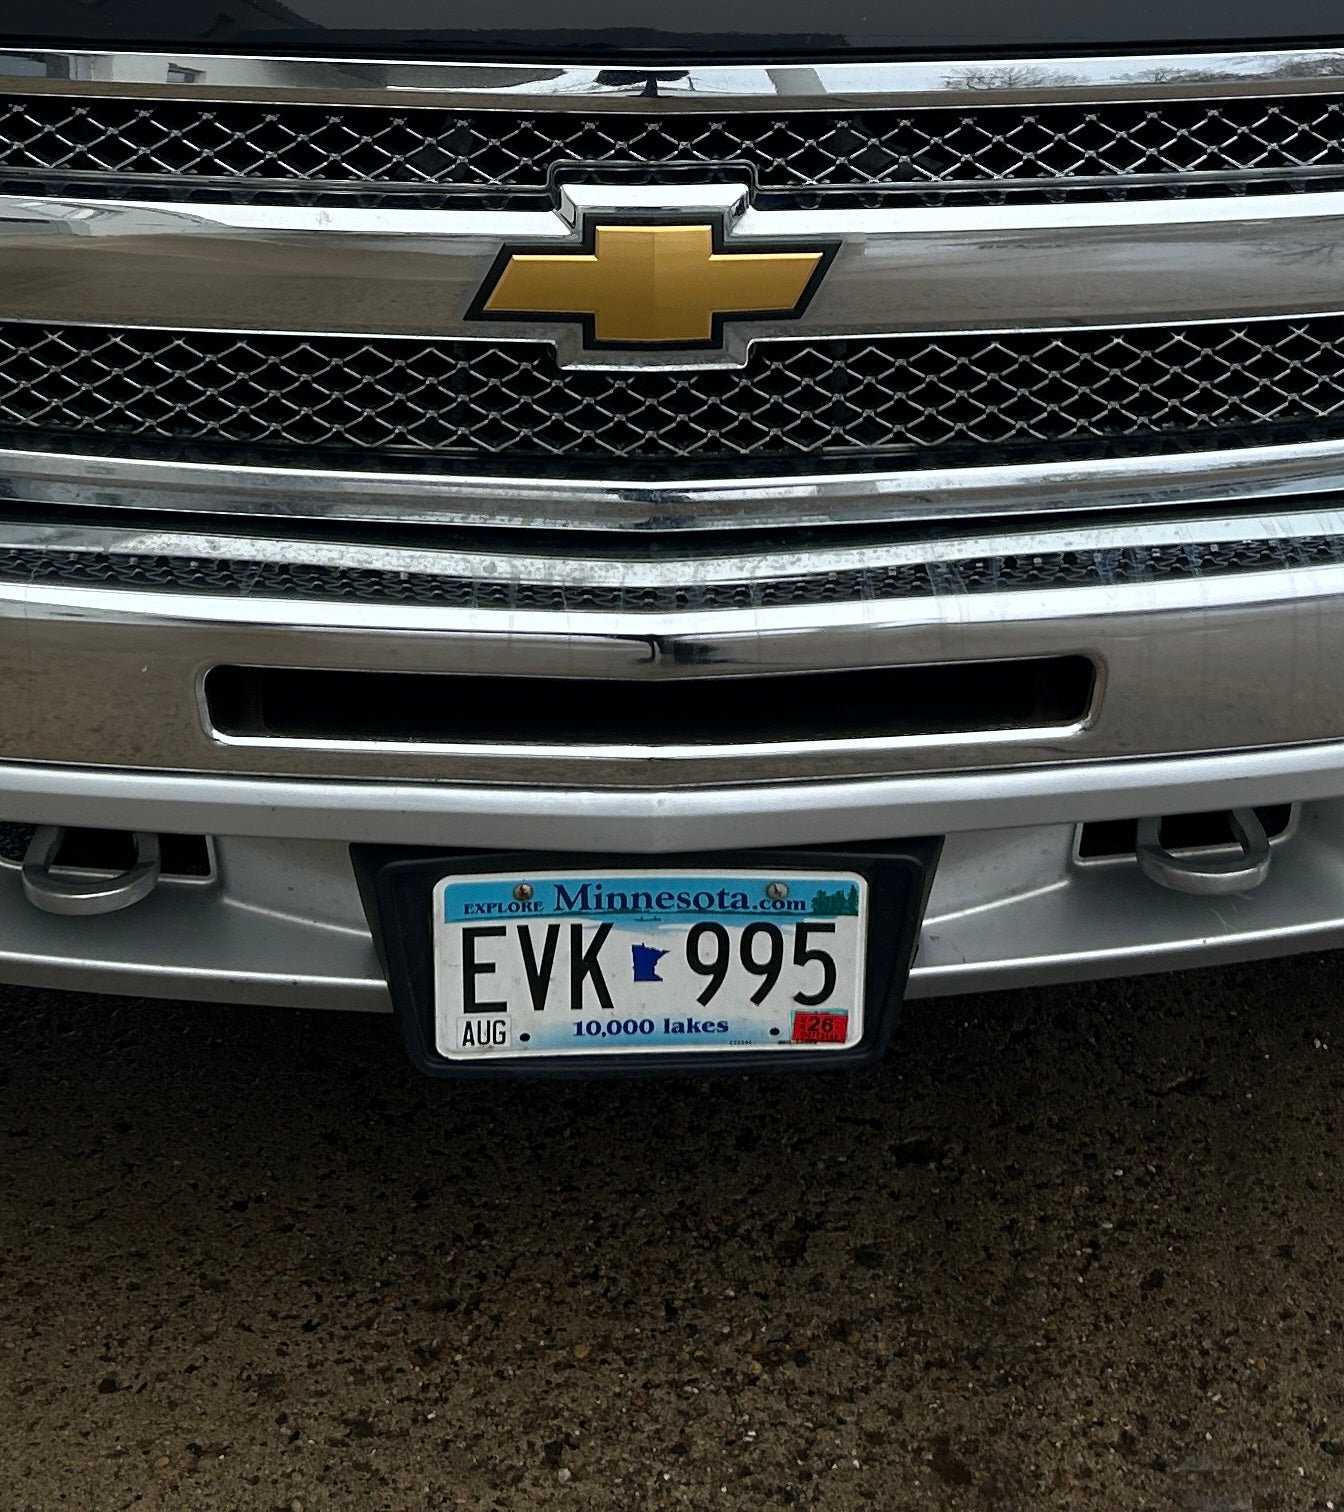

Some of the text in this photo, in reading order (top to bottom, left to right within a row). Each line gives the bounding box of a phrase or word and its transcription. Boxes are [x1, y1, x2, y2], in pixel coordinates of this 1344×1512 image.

[464, 883, 806, 914] EXPLORE Minnesota.com
[462, 921, 837, 1014] EVK 995
[462, 1019, 507, 1047] AUG
[573, 1018, 729, 1037] 10,000 lakes
[806, 1016, 834, 1033] 26
